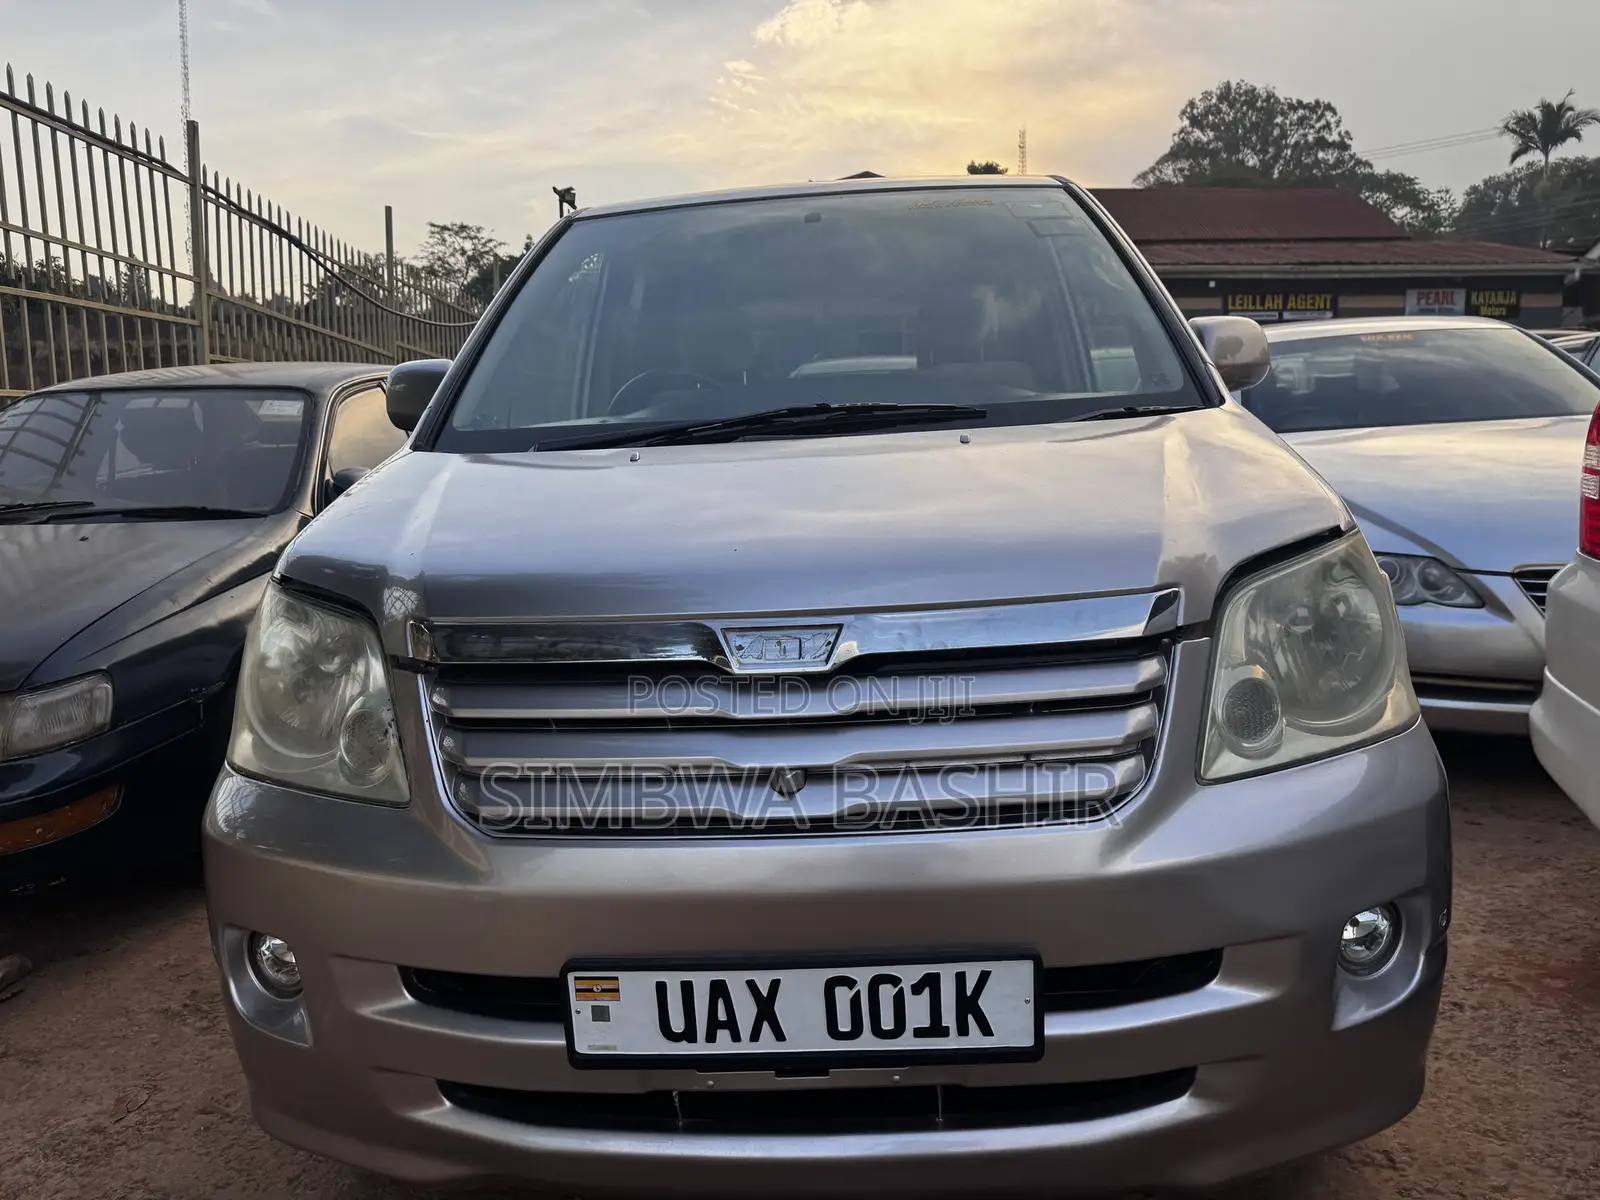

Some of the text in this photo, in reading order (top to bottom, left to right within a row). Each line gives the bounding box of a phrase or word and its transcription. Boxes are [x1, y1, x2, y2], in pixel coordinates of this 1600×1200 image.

[1228, 294, 1332, 310] LEILLAH AGENT
[1417, 289, 1456, 306] PEARL
[655, 969, 995, 1044] UAX 001K
